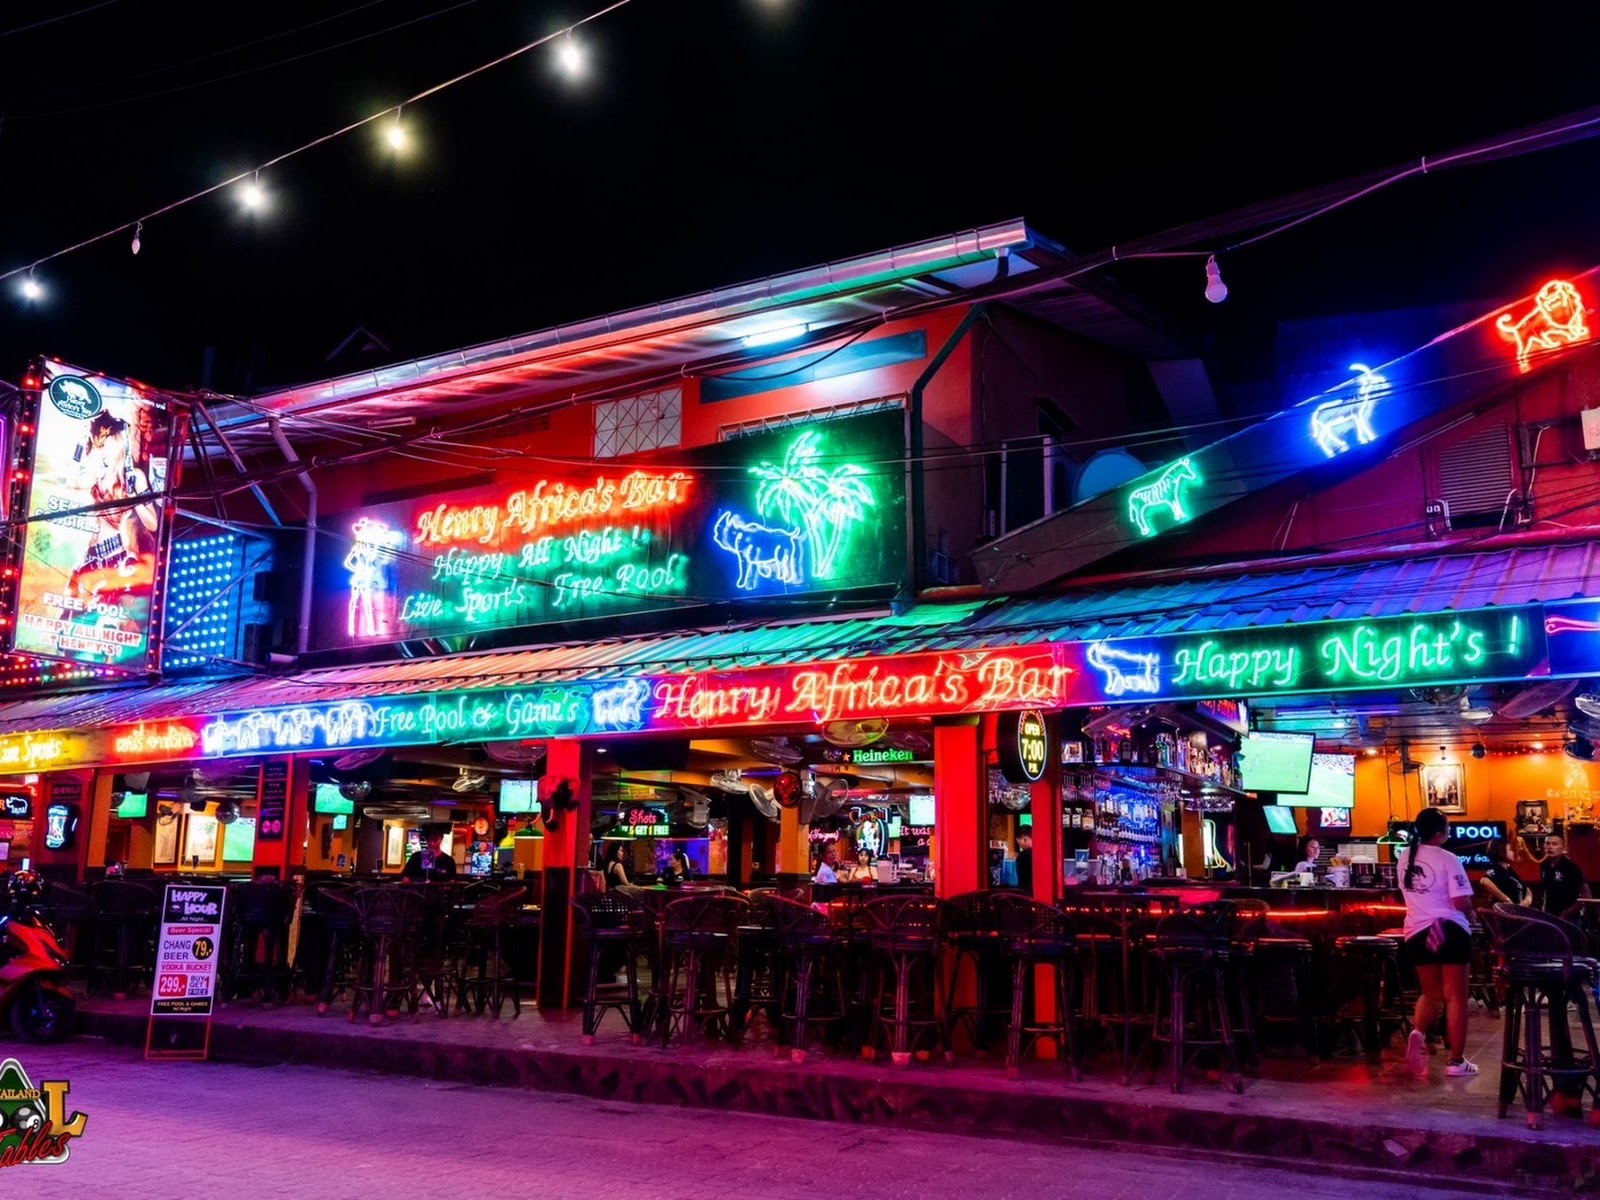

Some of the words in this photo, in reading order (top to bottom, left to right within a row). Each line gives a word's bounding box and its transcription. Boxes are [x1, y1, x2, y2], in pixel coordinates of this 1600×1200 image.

[414, 503, 499, 544] Henry
[503, 476, 615, 533] Africa's
[620, 470, 694, 509] Bar
[432, 547, 504, 585] Happy
[518, 536, 554, 568] All
[564, 526, 622, 564] Night
[398, 593, 444, 620] Live
[455, 578, 526, 621] Sport's
[553, 573, 605, 606] Free
[616, 554, 678, 592] Pool
[43, 593, 83, 612] FREE
[87, 600, 127, 619] POOL
[24, 615, 71, 635] HAPPY
[102, 628, 142, 648] NIGHT
[41, 634, 58, 647] AT
[1172, 641, 1295, 688] Happy
[1322, 621, 1484, 681] Night's
[654, 676, 771, 721] Henry
[785, 662, 963, 724] Africa's
[978, 657, 1072, 701] Bar
[374, 706, 415, 737] Free
[419, 696, 468, 734] Pool
[472, 704, 498, 728] &
[506, 693, 578, 735] Game's
[853, 748, 913, 763] Heineken
[1021, 738, 1044, 761] 7:00
[629, 809, 657, 825] Shots
[635, 825, 648, 836] GET
[653, 825, 670, 836] FREE
[1456, 826, 1502, 838] POOL
[172, 889, 208, 902] HAPPY
[184, 902, 218, 915] HOUR
[163, 940, 192, 950] CHANG
[163, 952, 189, 960] BEER
[186, 963, 212, 971] BUCKET
